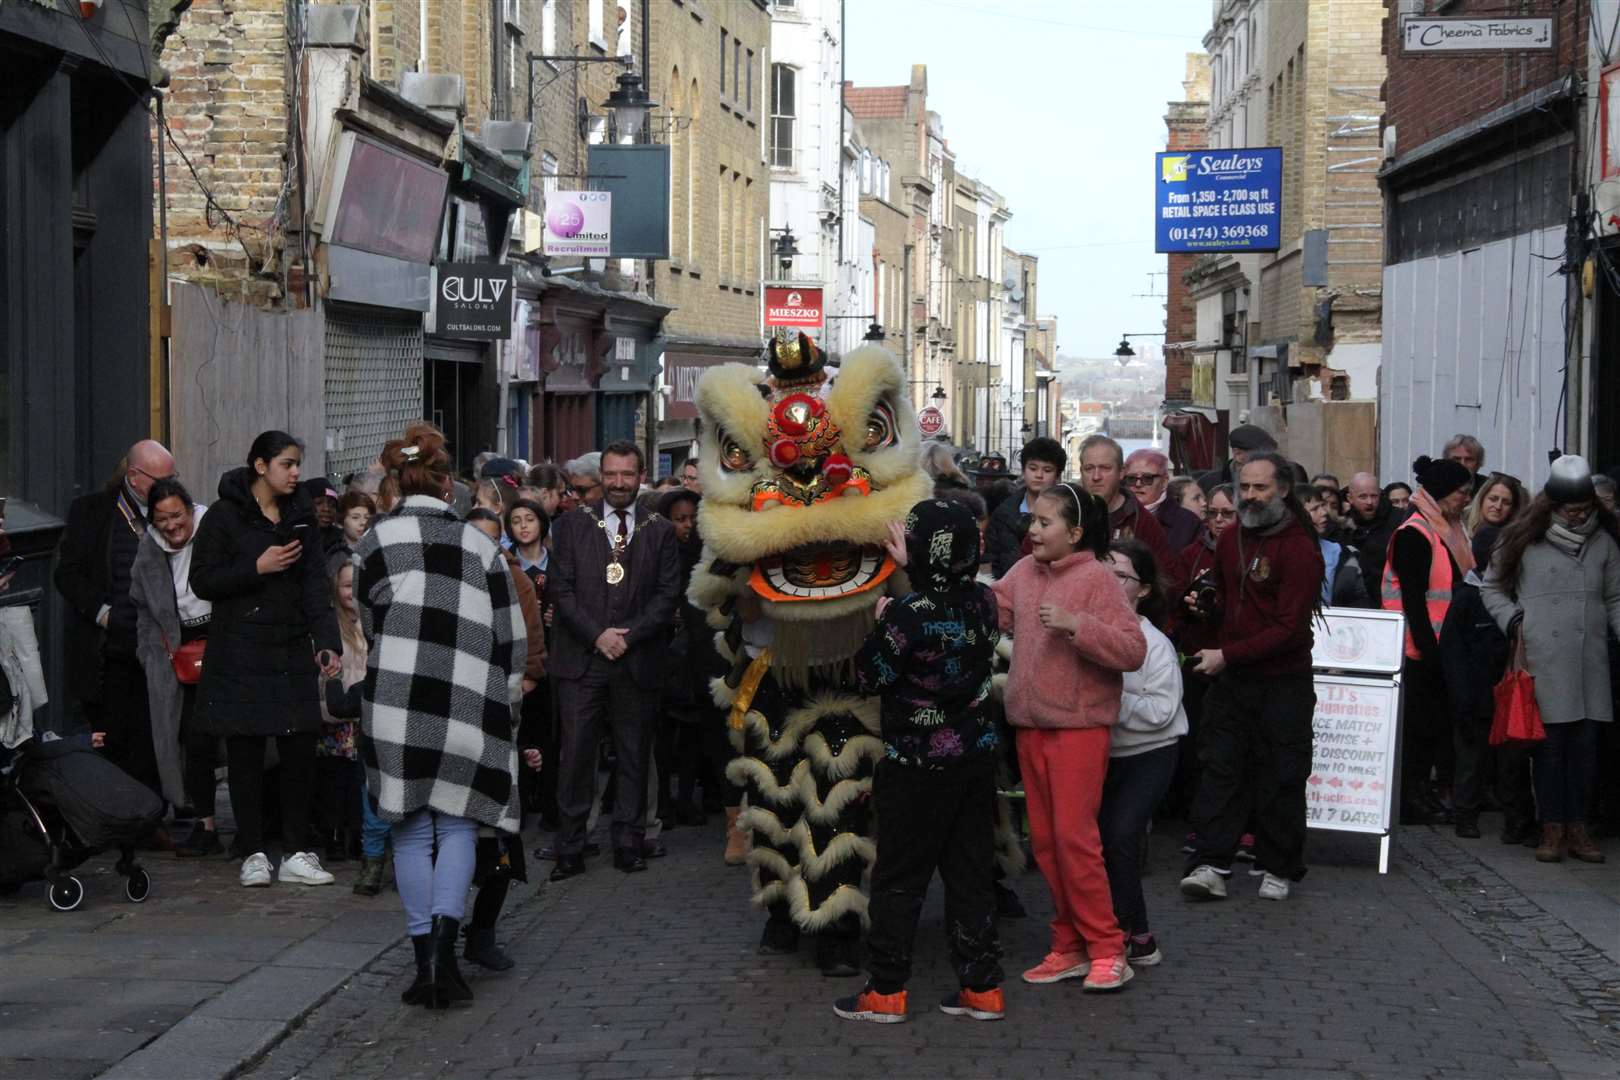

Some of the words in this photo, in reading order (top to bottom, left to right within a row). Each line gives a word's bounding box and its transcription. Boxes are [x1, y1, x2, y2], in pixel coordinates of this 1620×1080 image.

[1420, 24, 1482, 46] Cheema
[1488, 23, 1533, 37] Fabrics
[1197, 154, 1263, 175] Sealeys
[1168, 192, 1190, 203] From
[1192, 190, 1216, 204] 1,350
[1223, 189, 1248, 203] 2,700
[1249, 190, 1260, 202] sq
[1261, 188, 1269, 200] ft
[1162, 206, 1191, 218] RETAIL
[1192, 204, 1220, 217] SPACE
[1221, 204, 1228, 216] E
[1229, 203, 1256, 216] CLASS
[1258, 202, 1276, 214] USE
[566, 232, 608, 240] Limited
[1169, 226, 1218, 241] (01474)
[1221, 224, 1269, 238] 369368
[547, 245, 609, 253] Recruitment
[769, 308, 819, 317] MIESZKO
[447, 323, 501, 332] CULTSALONS.COM
[1336, 720, 1383, 734] MATCH
[1313, 731, 1360, 745] ROMISE
[1321, 747, 1385, 762] DISCOUNT
[1306, 807, 1323, 820] EN
[1328, 807, 1337, 821] 7
[1340, 810, 1379, 825] DAYS
